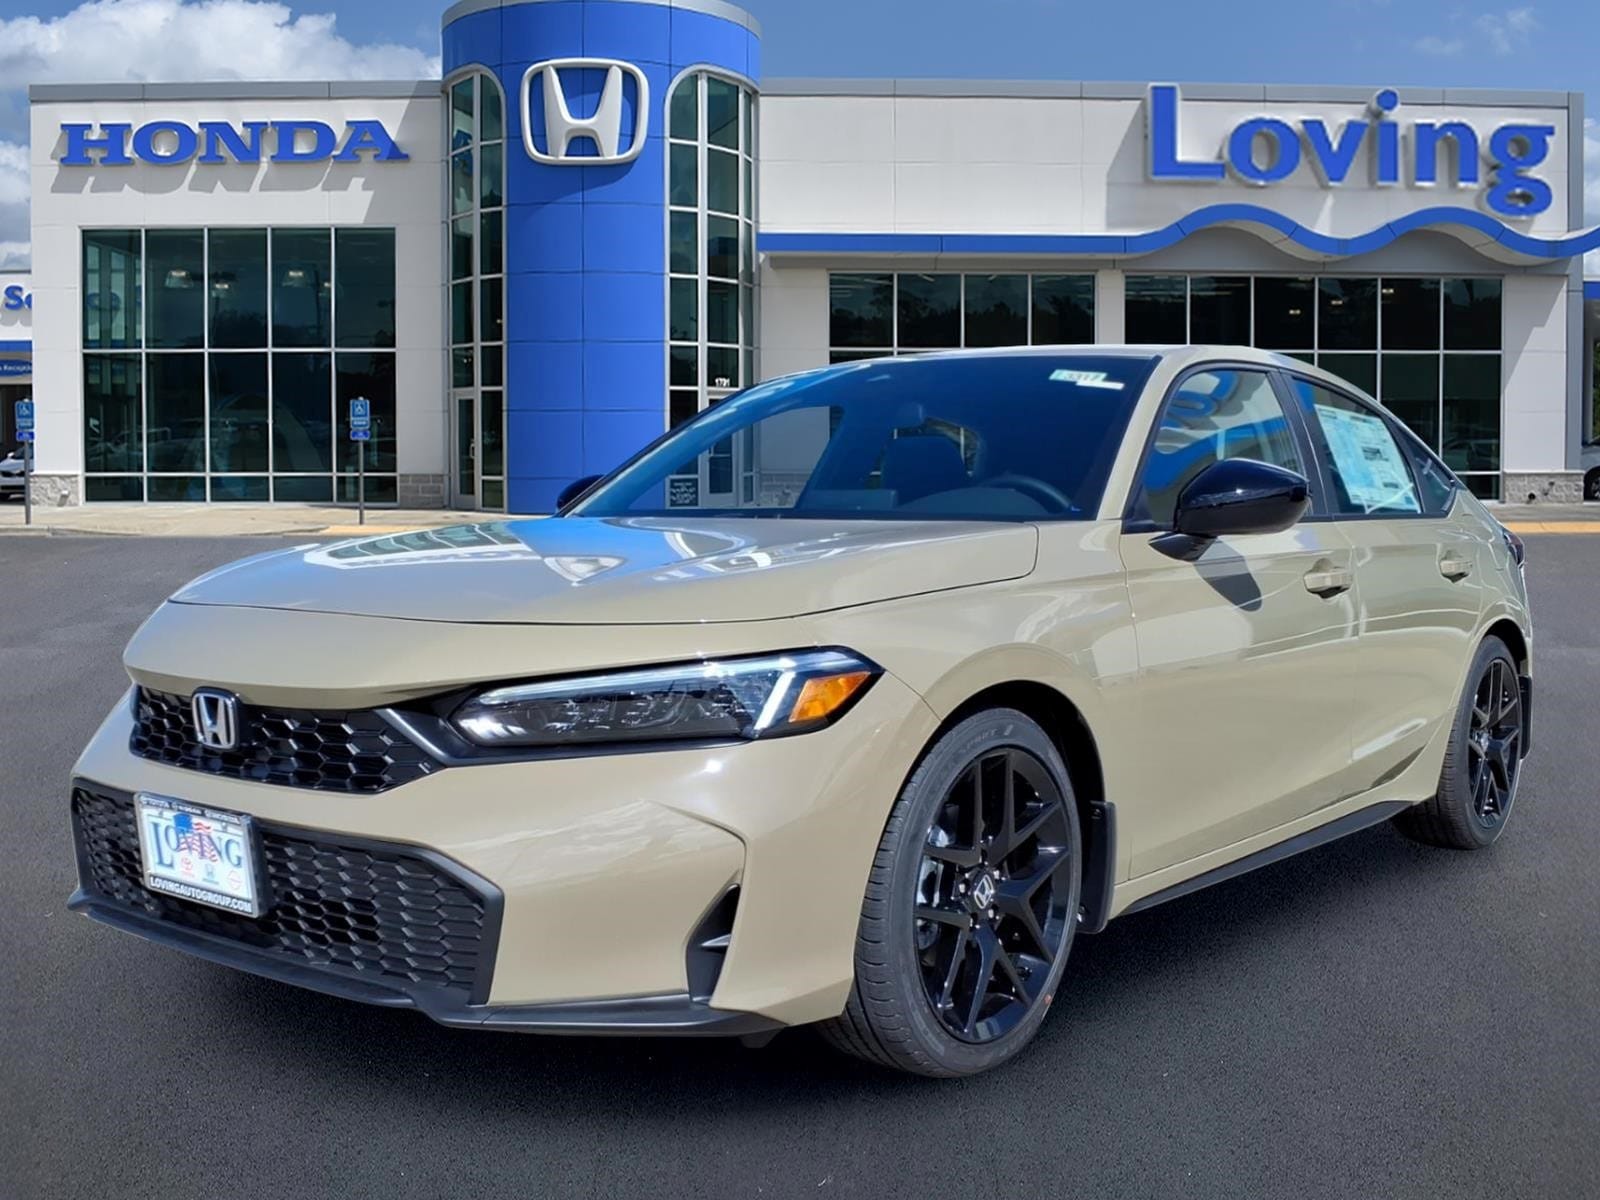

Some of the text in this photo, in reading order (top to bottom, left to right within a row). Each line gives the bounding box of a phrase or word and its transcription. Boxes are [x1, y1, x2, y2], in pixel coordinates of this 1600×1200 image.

[60, 119, 409, 166] HONDA
[1147, 83, 1556, 217] Loving
[151, 822, 242, 869] LOVING
[150, 876, 252, 912] LOVINGAUTOGROUP.COM
